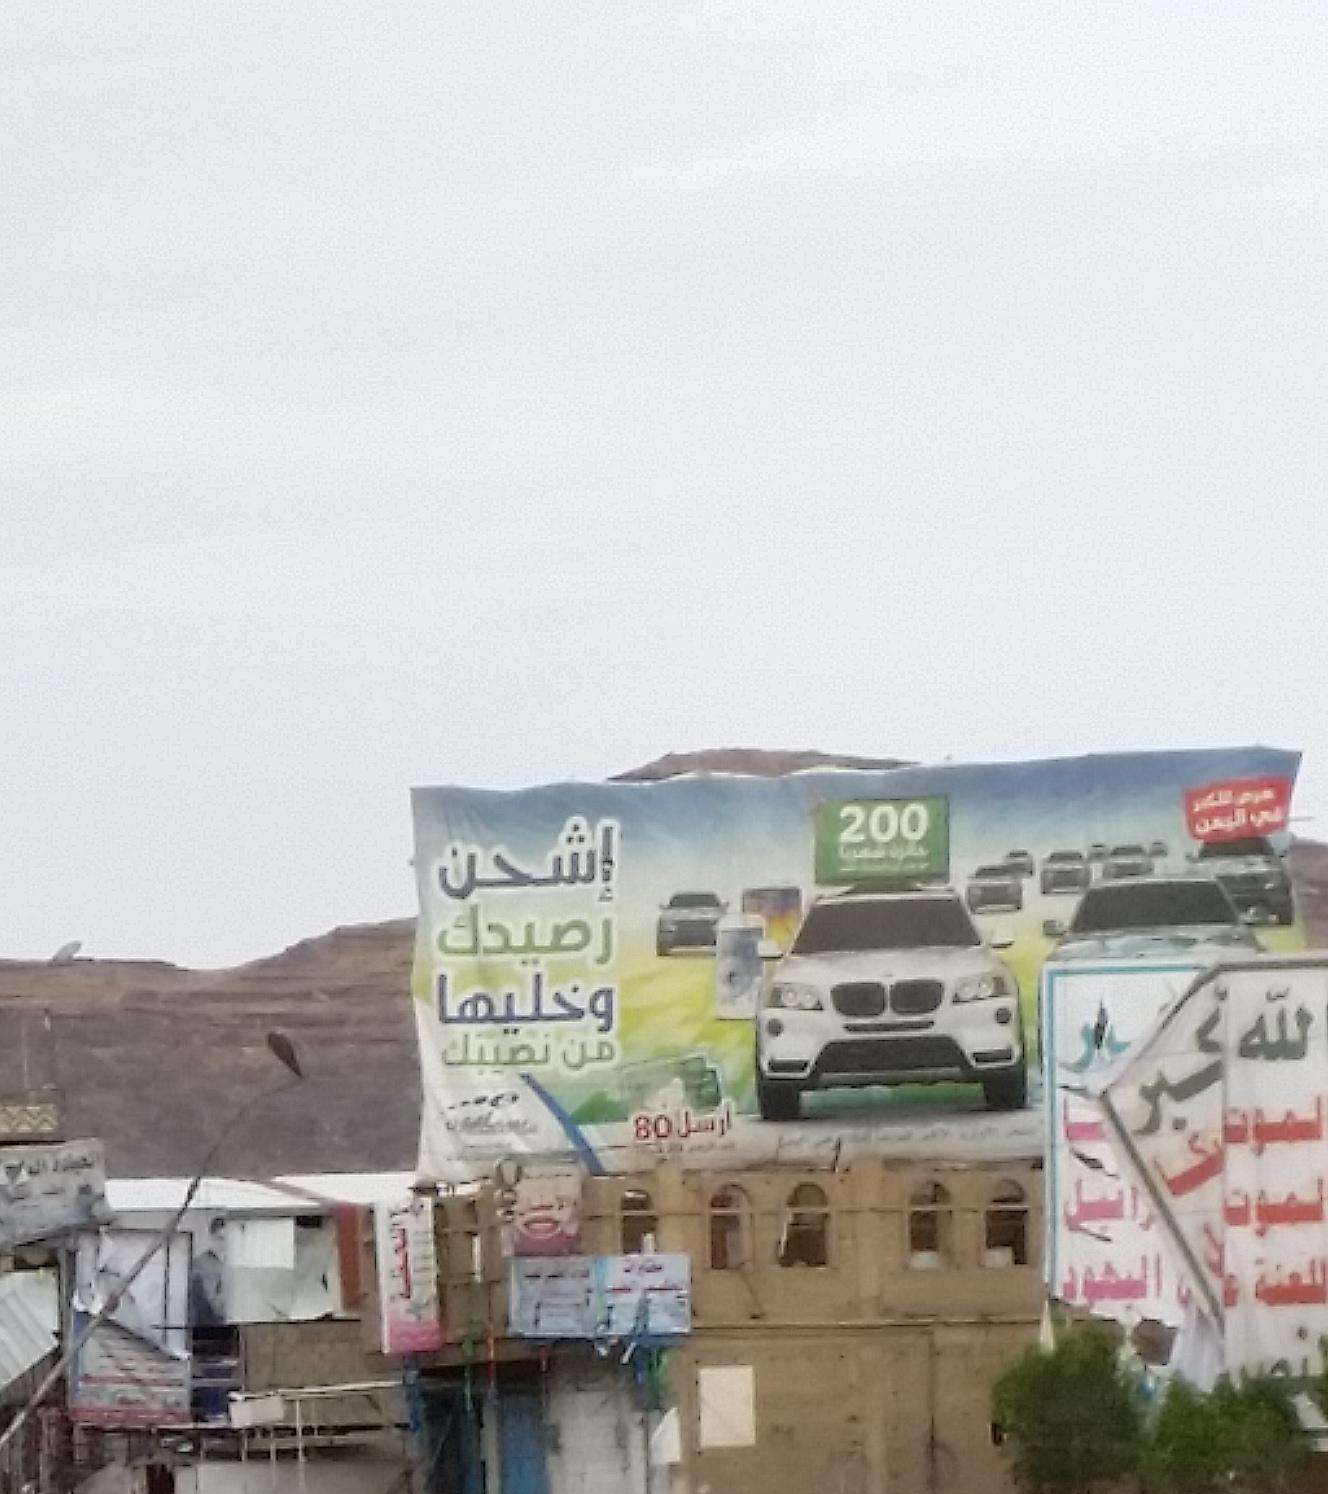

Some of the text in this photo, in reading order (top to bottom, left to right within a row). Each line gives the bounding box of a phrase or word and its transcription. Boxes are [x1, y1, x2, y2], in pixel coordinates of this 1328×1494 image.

[839, 803, 929, 843] 200
[438, 903, 613, 966] رصيدك
[439, 973, 615, 1036] وخليها
[441, 1032, 615, 1076] من نصيبك
[633, 1113, 672, 1140] 80
[1225, 1096, 1323, 1157] لموت
[1225, 1176, 1324, 1238] لموت
